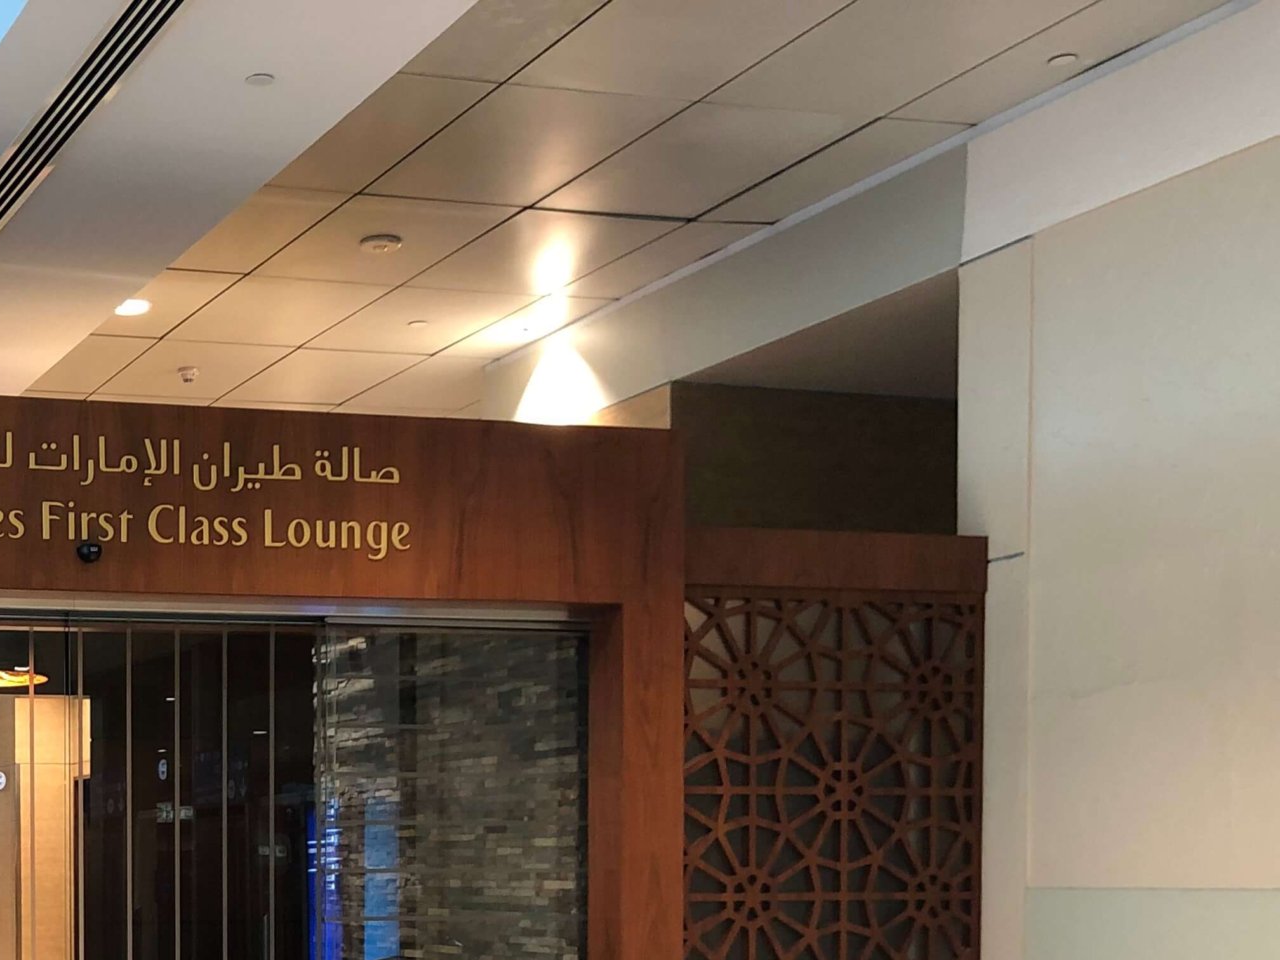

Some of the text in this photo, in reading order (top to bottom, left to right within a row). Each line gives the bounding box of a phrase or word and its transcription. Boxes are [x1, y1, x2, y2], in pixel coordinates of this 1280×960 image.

[28, 434, 180, 486] الإمارات
[193, 442, 302, 492] طيران
[314, 446, 400, 484] صالة
[41, 501, 133, 542] First
[148, 504, 248, 546] Class
[264, 509, 411, 560] Lounge
